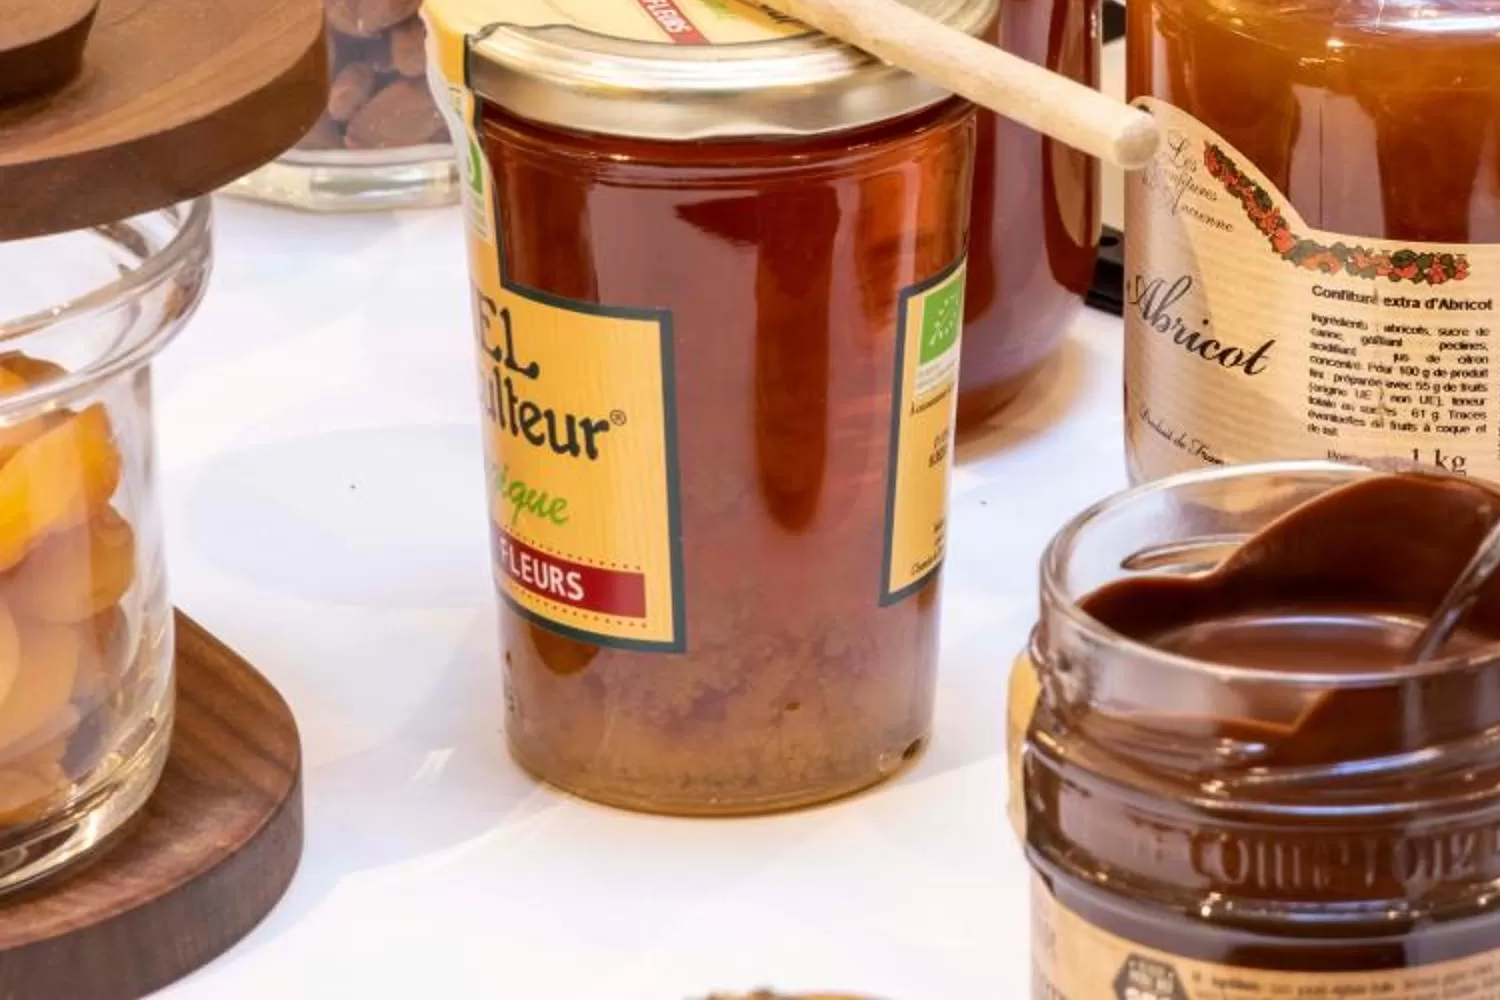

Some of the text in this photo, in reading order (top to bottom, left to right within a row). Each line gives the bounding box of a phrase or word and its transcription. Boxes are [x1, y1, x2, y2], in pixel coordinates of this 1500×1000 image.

[1383, 297, 1420, 309] extra
[1425, 298, 1493, 311] d'Abricot
[1128, 275, 1276, 377] Abricot
[1438, 327, 1470, 336] sucre
[1475, 327, 1490, 336] de
[1426, 354, 1441, 364] de
[1433, 369, 1448, 377] de
[1443, 383, 1458, 393] de
[499, 537, 585, 601] FLEURS
